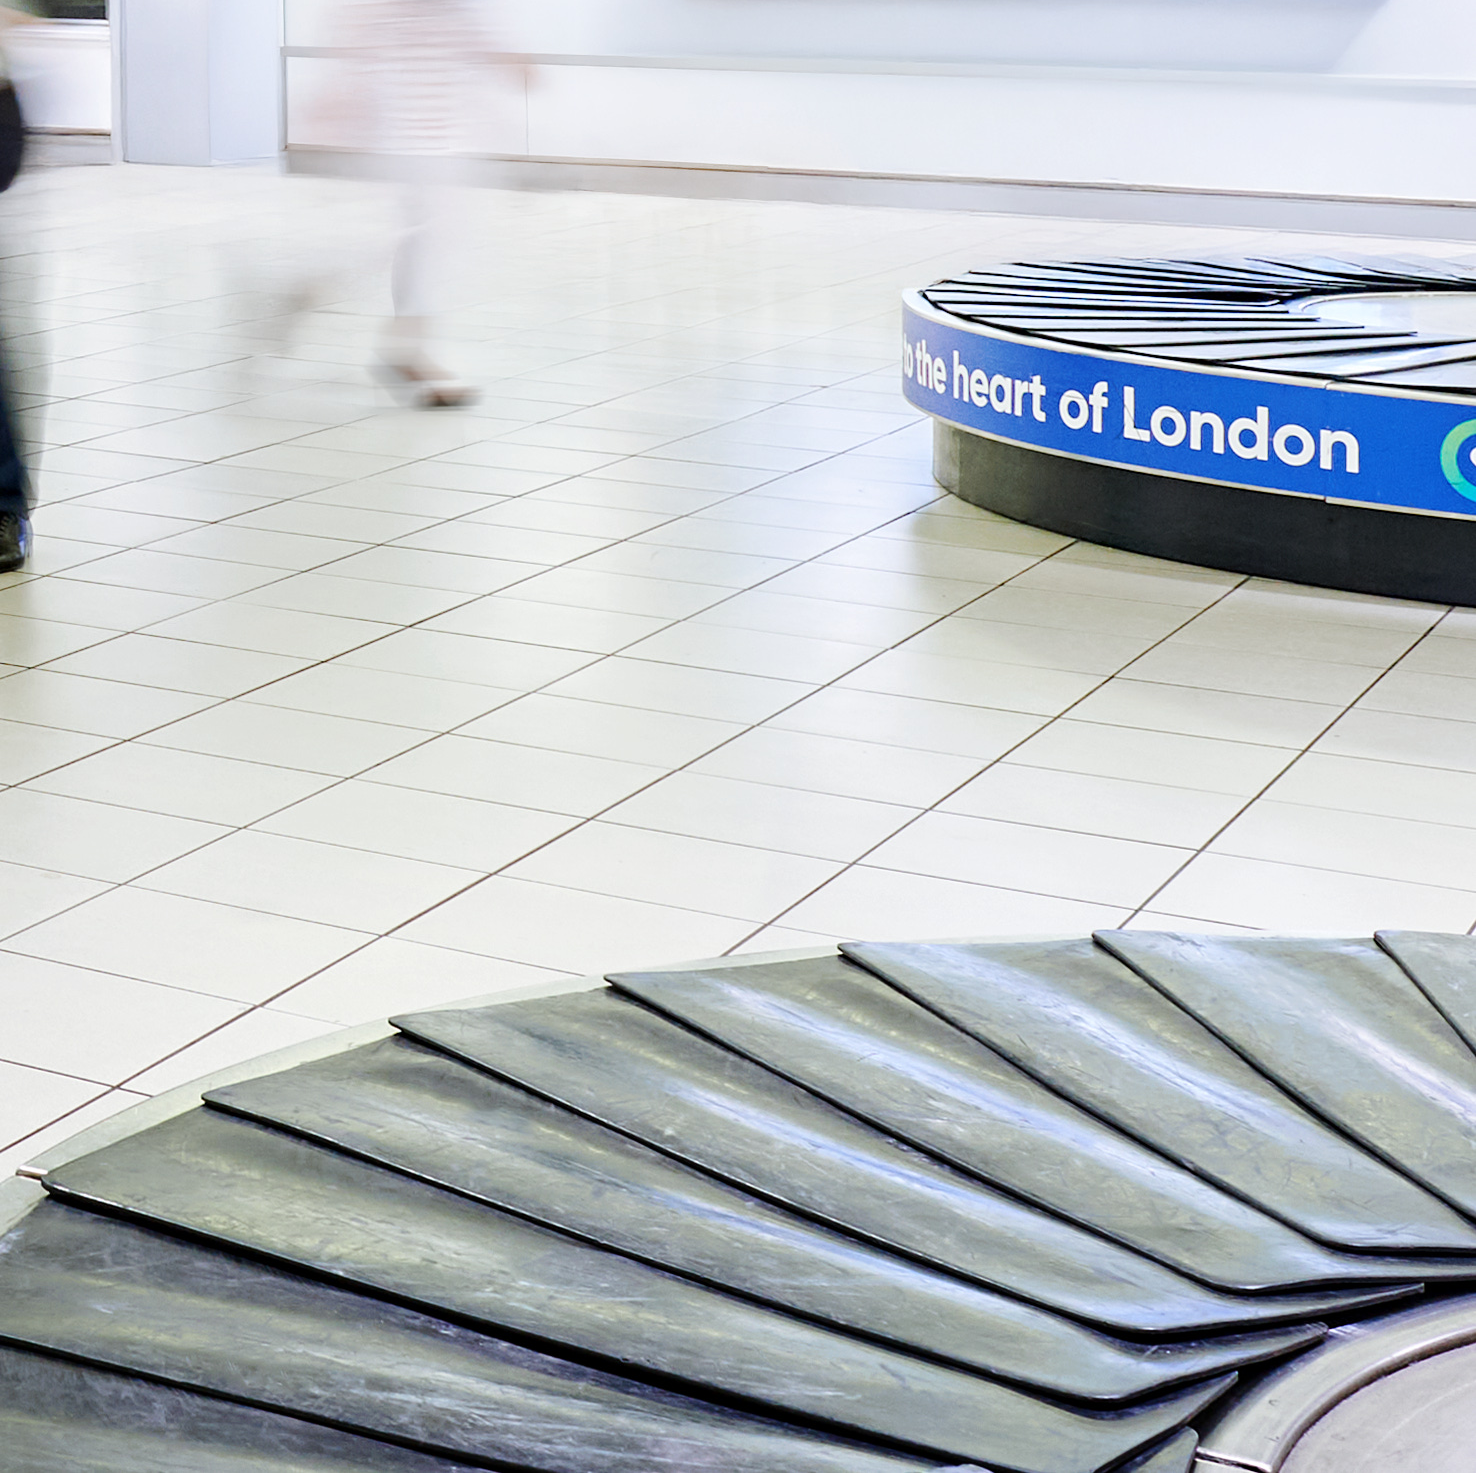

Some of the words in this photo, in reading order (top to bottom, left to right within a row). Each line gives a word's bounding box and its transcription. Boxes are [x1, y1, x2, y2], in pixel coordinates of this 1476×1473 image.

[903, 332, 914, 379] to
[915, 339, 947, 395] the
[952, 349, 1047, 424] heart
[1059, 381, 1109, 435] of
[1123, 385, 1360, 474] London
